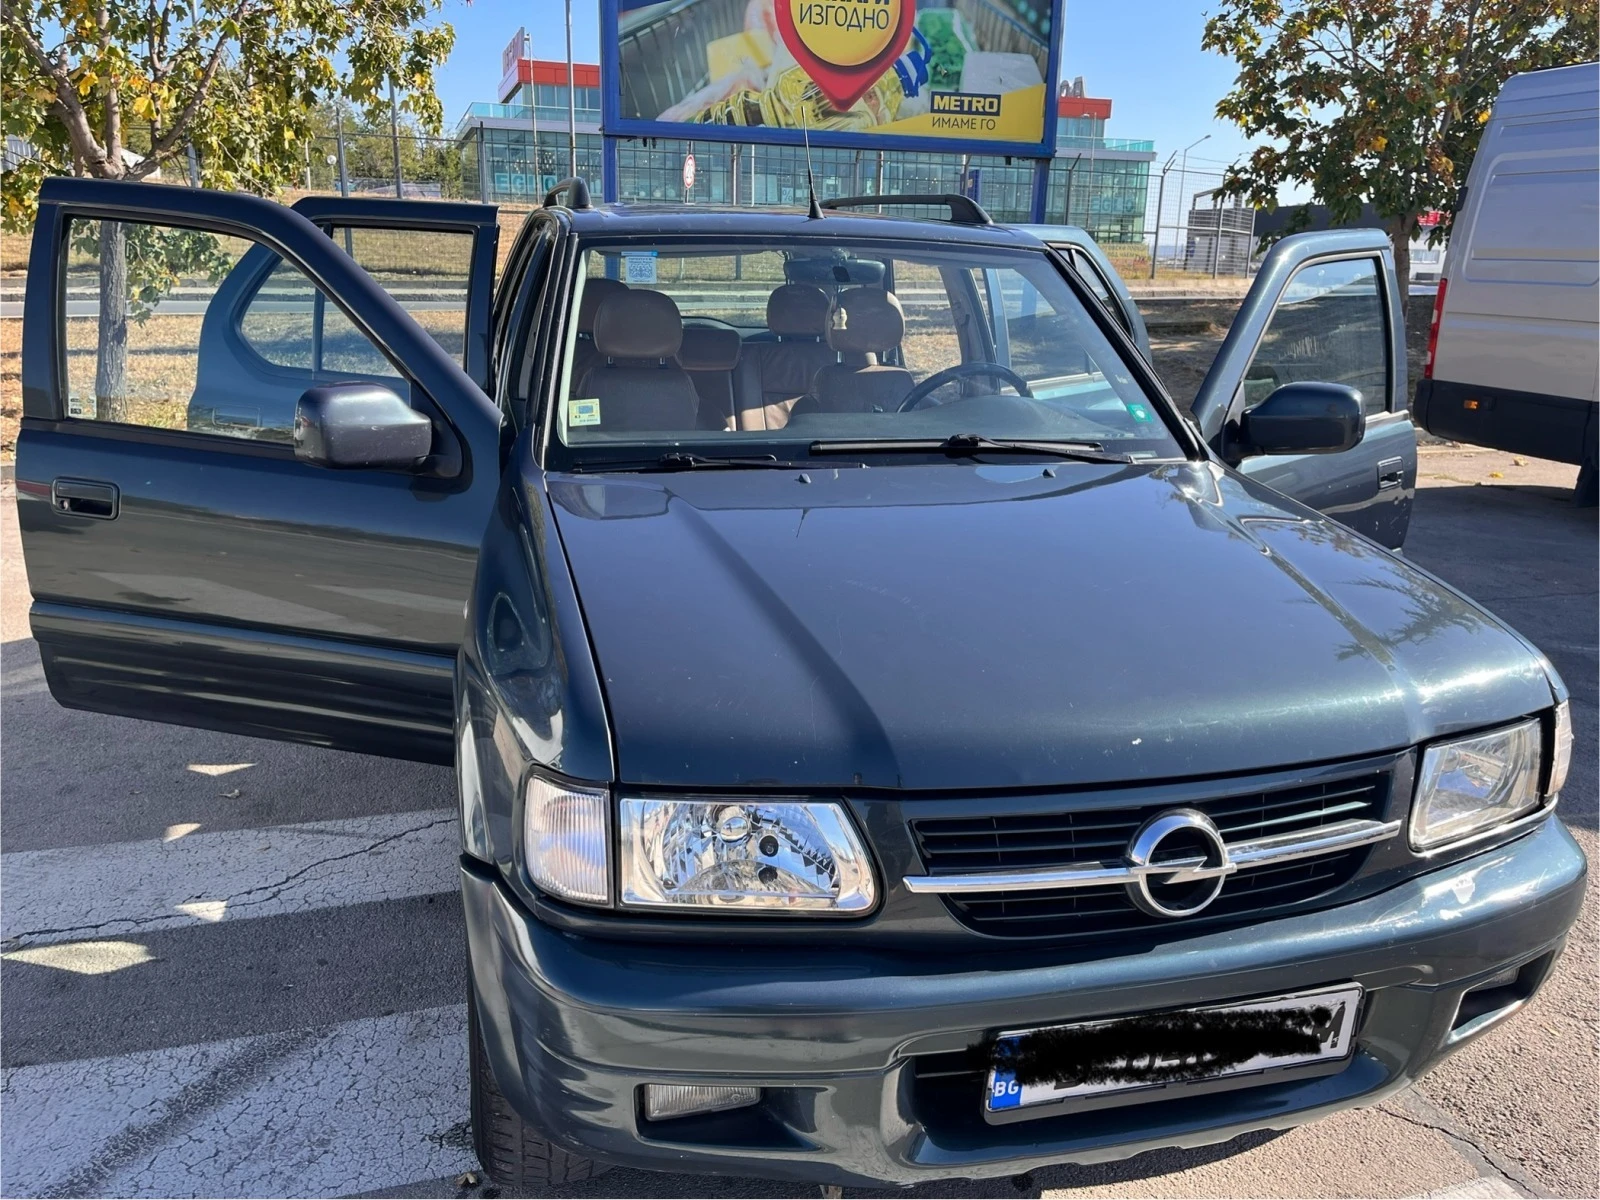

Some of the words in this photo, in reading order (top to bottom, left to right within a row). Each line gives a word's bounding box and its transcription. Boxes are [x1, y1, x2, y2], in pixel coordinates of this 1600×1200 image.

[799, 3, 890, 32] ИЗГОДНО
[933, 94, 999, 113] METRO
[931, 116, 977, 130] ИМАМЕ
[980, 118, 996, 131] ГО
[994, 1080, 1019, 1098] BG
